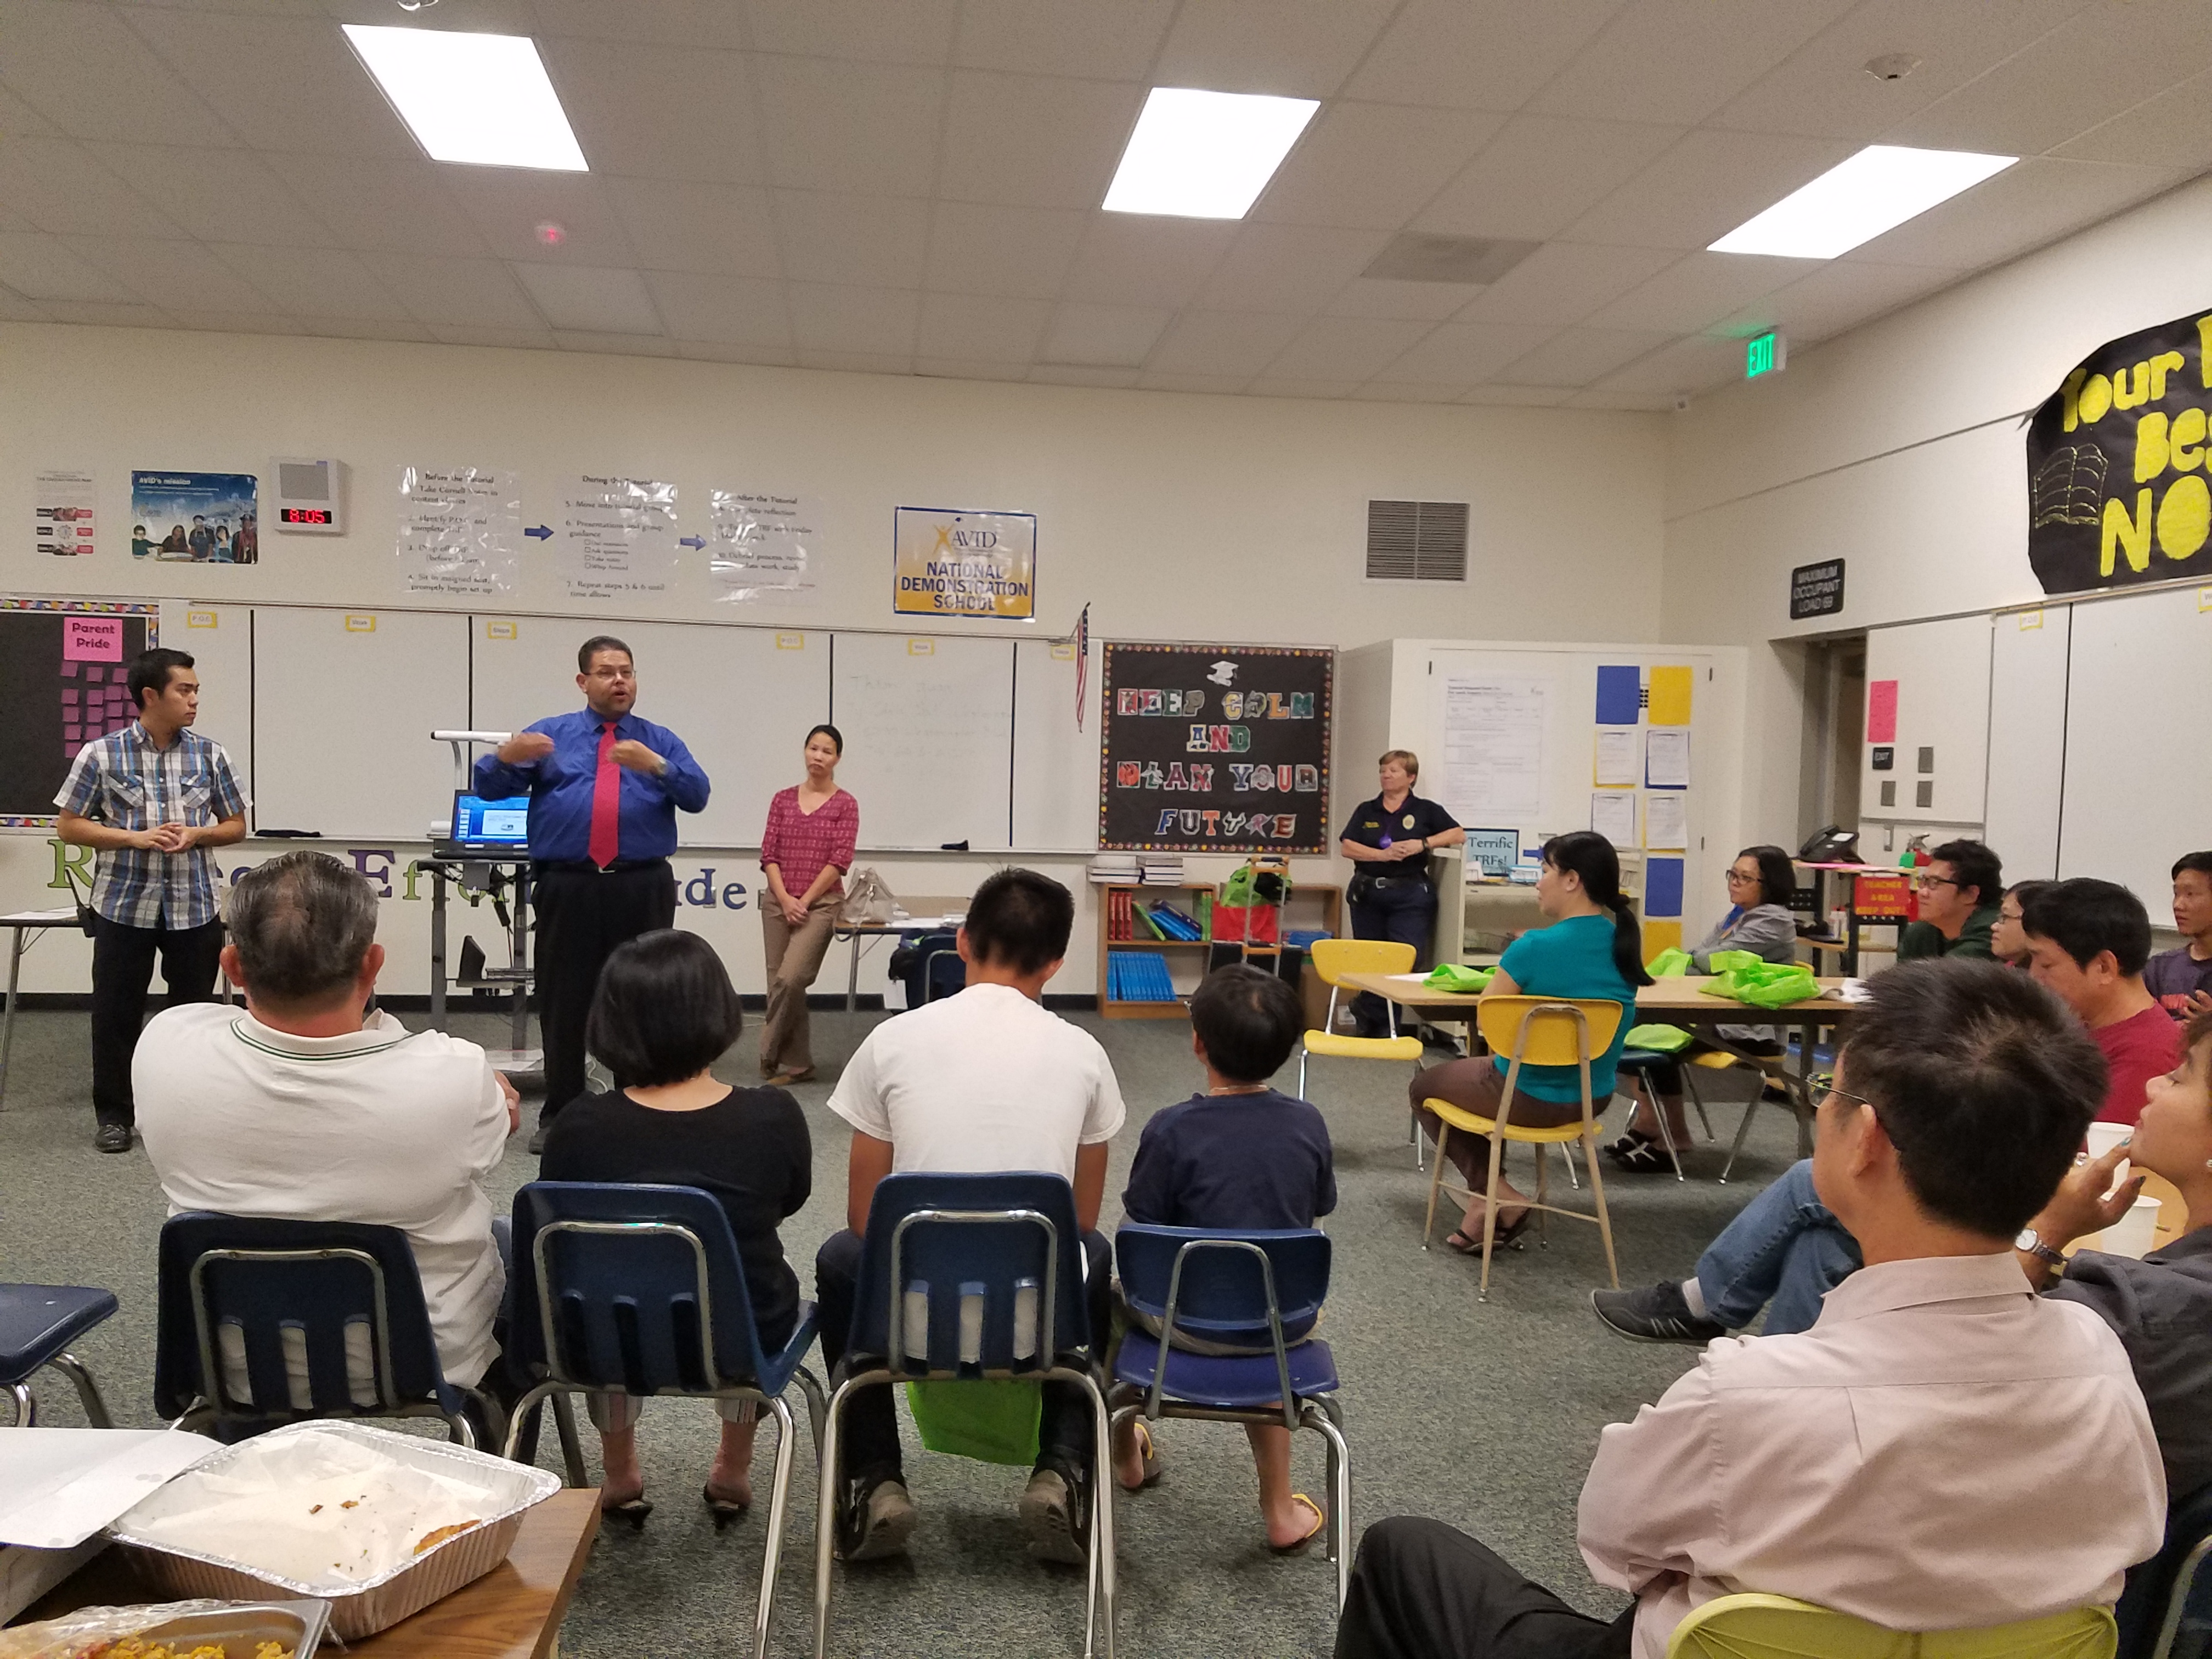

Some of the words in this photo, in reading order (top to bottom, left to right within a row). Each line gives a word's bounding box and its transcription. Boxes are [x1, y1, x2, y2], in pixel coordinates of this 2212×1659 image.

[1748, 334, 1776, 378] EXIT
[2059, 351, 2185, 433] Your
[2134, 408, 2212, 483] Be
[289, 509, 325, 523] 8:05
[951, 530, 997, 548] AVID
[927, 561, 1004, 579] NATIONAL
[901, 576, 1029, 596] DEMONSTRATION
[934, 594, 996, 611] SCHOOL
[72, 622, 115, 634] Parent
[76, 637, 110, 648] Pride
[1186, 724, 1251, 752] AND
[1154, 809, 1297, 838] FUTURE
[1468, 836, 1513, 849] Terrific
